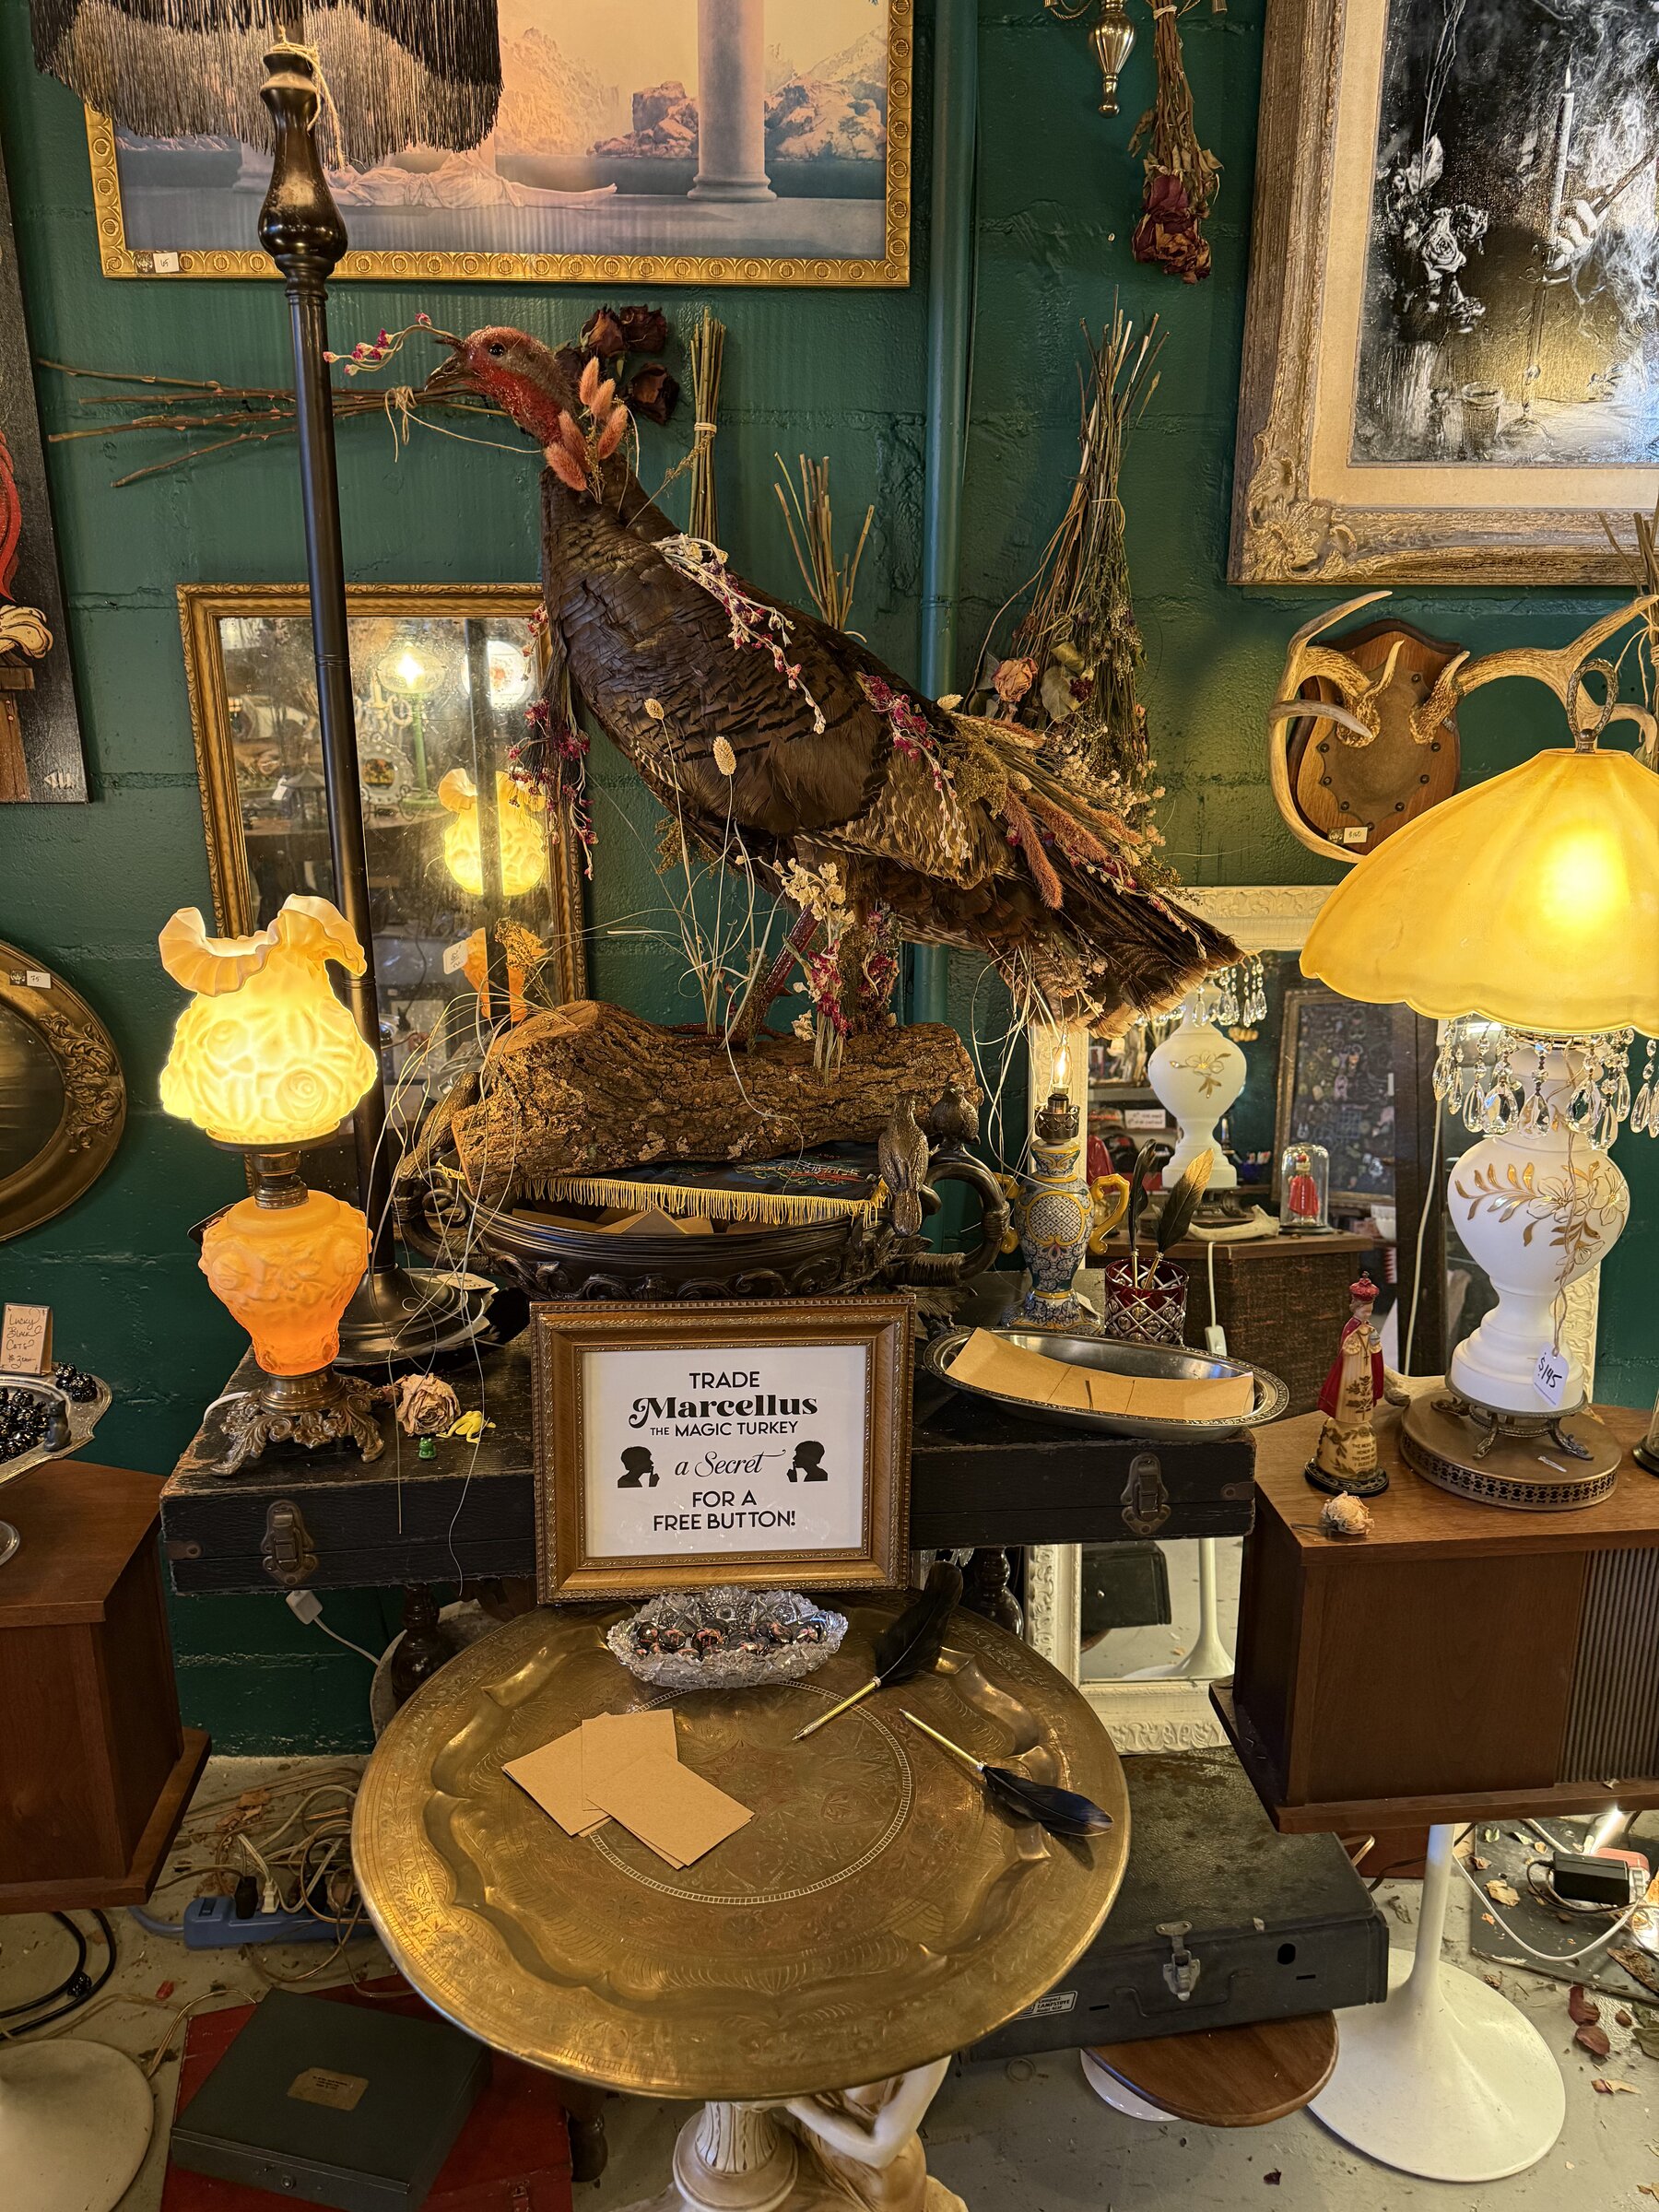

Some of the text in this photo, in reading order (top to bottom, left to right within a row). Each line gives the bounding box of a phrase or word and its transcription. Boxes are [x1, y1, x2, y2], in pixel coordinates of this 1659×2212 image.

[689, 1371, 760, 1389] TRADE
[1537, 1352, 1562, 1388] $145
[629, 1394, 818, 1429] Marcellus
[650, 1420, 798, 1437] THE MAGIC TURKEY
[675, 1449, 786, 1477] a Secret
[692, 1489, 758, 1508] FOR A
[653, 1510, 795, 1531] FREE BUTTON!
[1038, 1999, 1069, 2008] CAMPSTOVE
